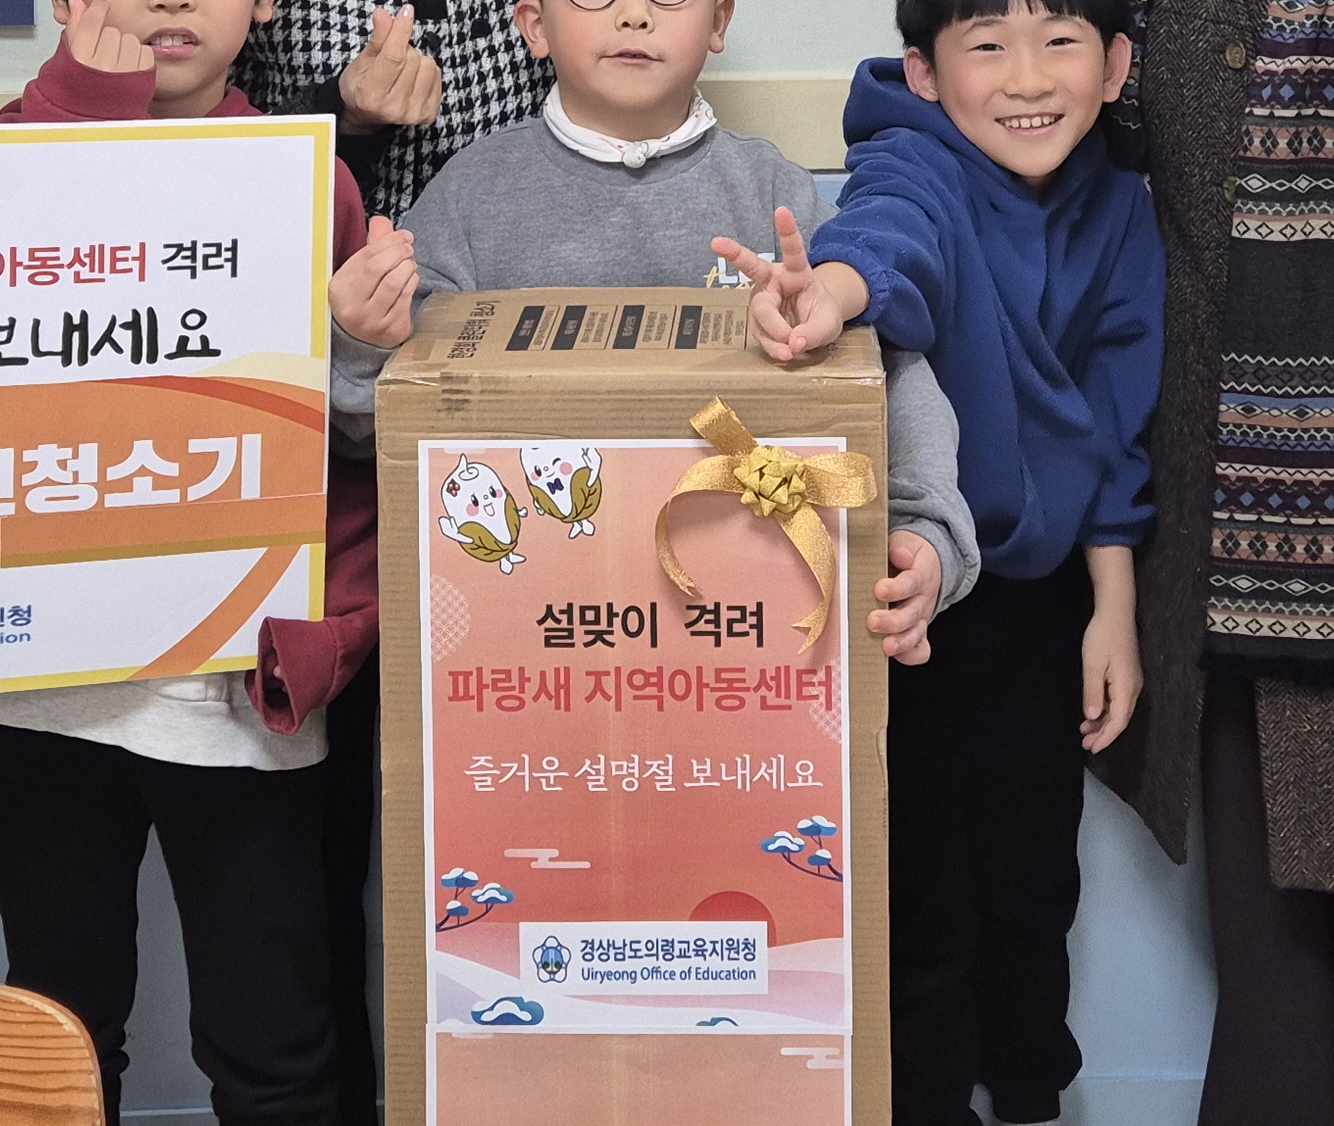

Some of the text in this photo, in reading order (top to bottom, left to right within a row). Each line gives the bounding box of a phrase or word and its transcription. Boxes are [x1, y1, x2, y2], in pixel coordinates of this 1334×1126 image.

[161, 240, 238, 278] 격려
[470, 300, 501, 318] 청소기
[535, 600, 765, 649] 설맞이 격려
[447, 664, 834, 712] 파랑새 지역아동센터
[465, 755, 823, 792] 즐거운 설명절 보내세요
[580, 938, 757, 962] 경상남도의령교육지원청
[581, 966, 757, 984] Uiryeong Office of Education
